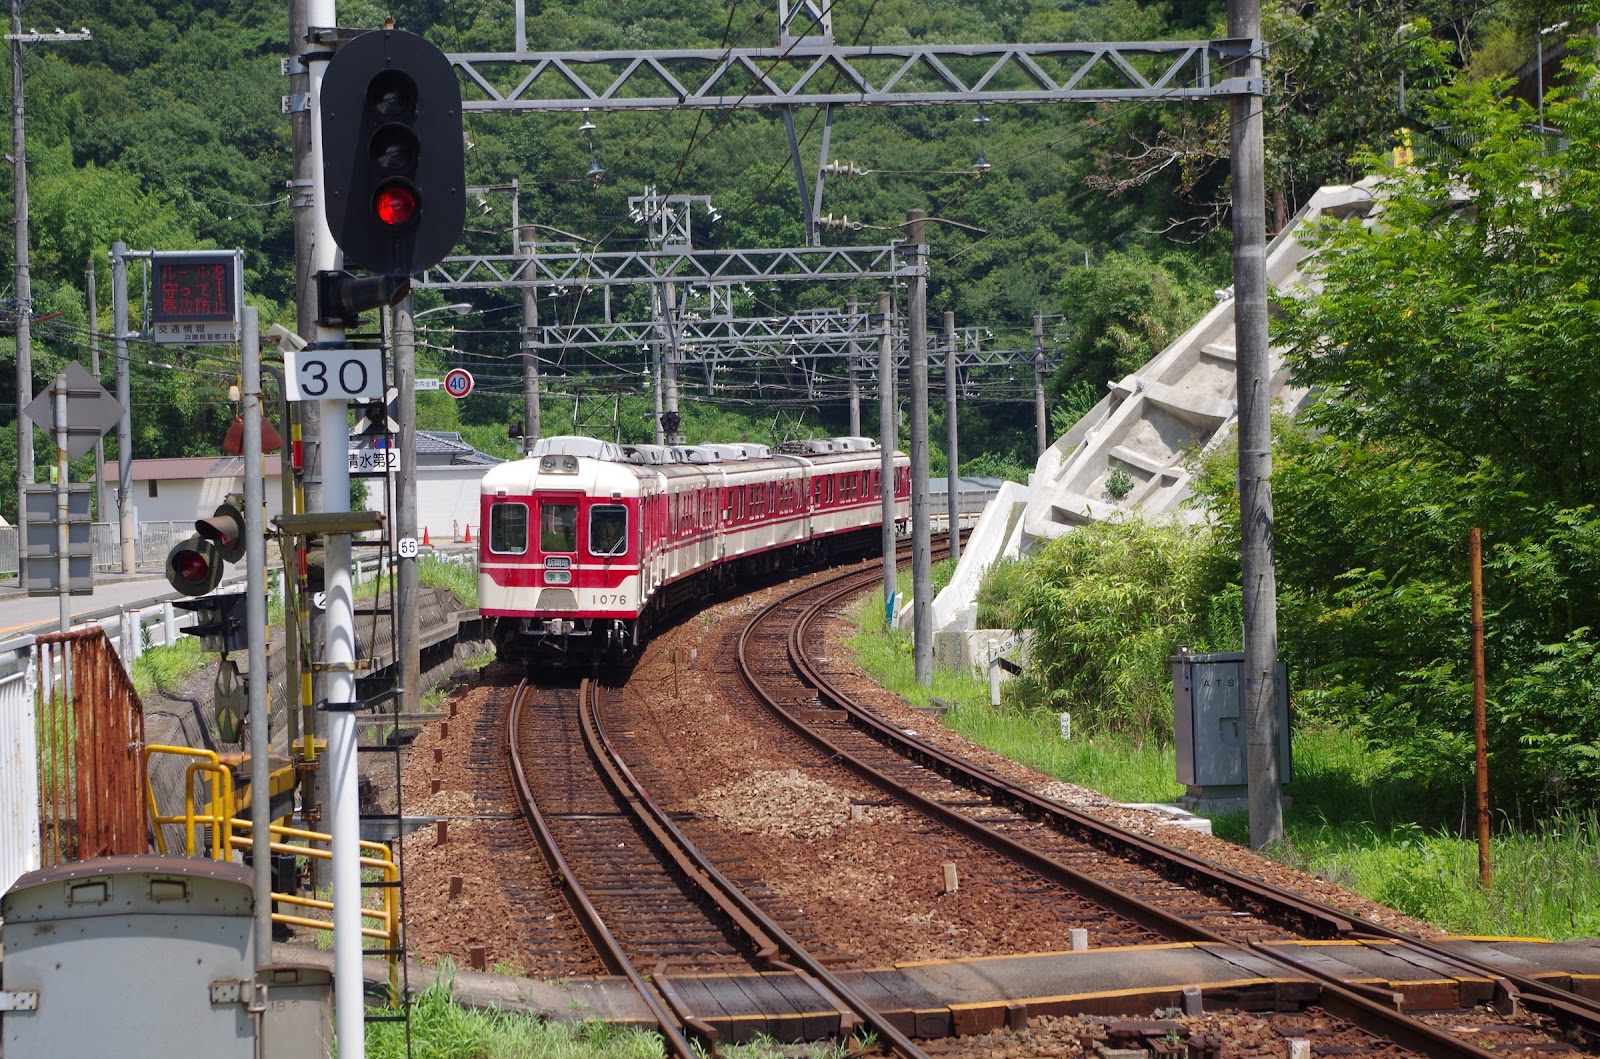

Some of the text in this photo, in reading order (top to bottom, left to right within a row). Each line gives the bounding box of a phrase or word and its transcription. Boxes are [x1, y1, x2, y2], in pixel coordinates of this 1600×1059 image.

[159, 325, 205, 334] 交通情報
[301, 359, 368, 396] 30
[450, 377, 466, 390] 40
[401, 541, 416, 554] 55
[592, 594, 627, 605] 1076
